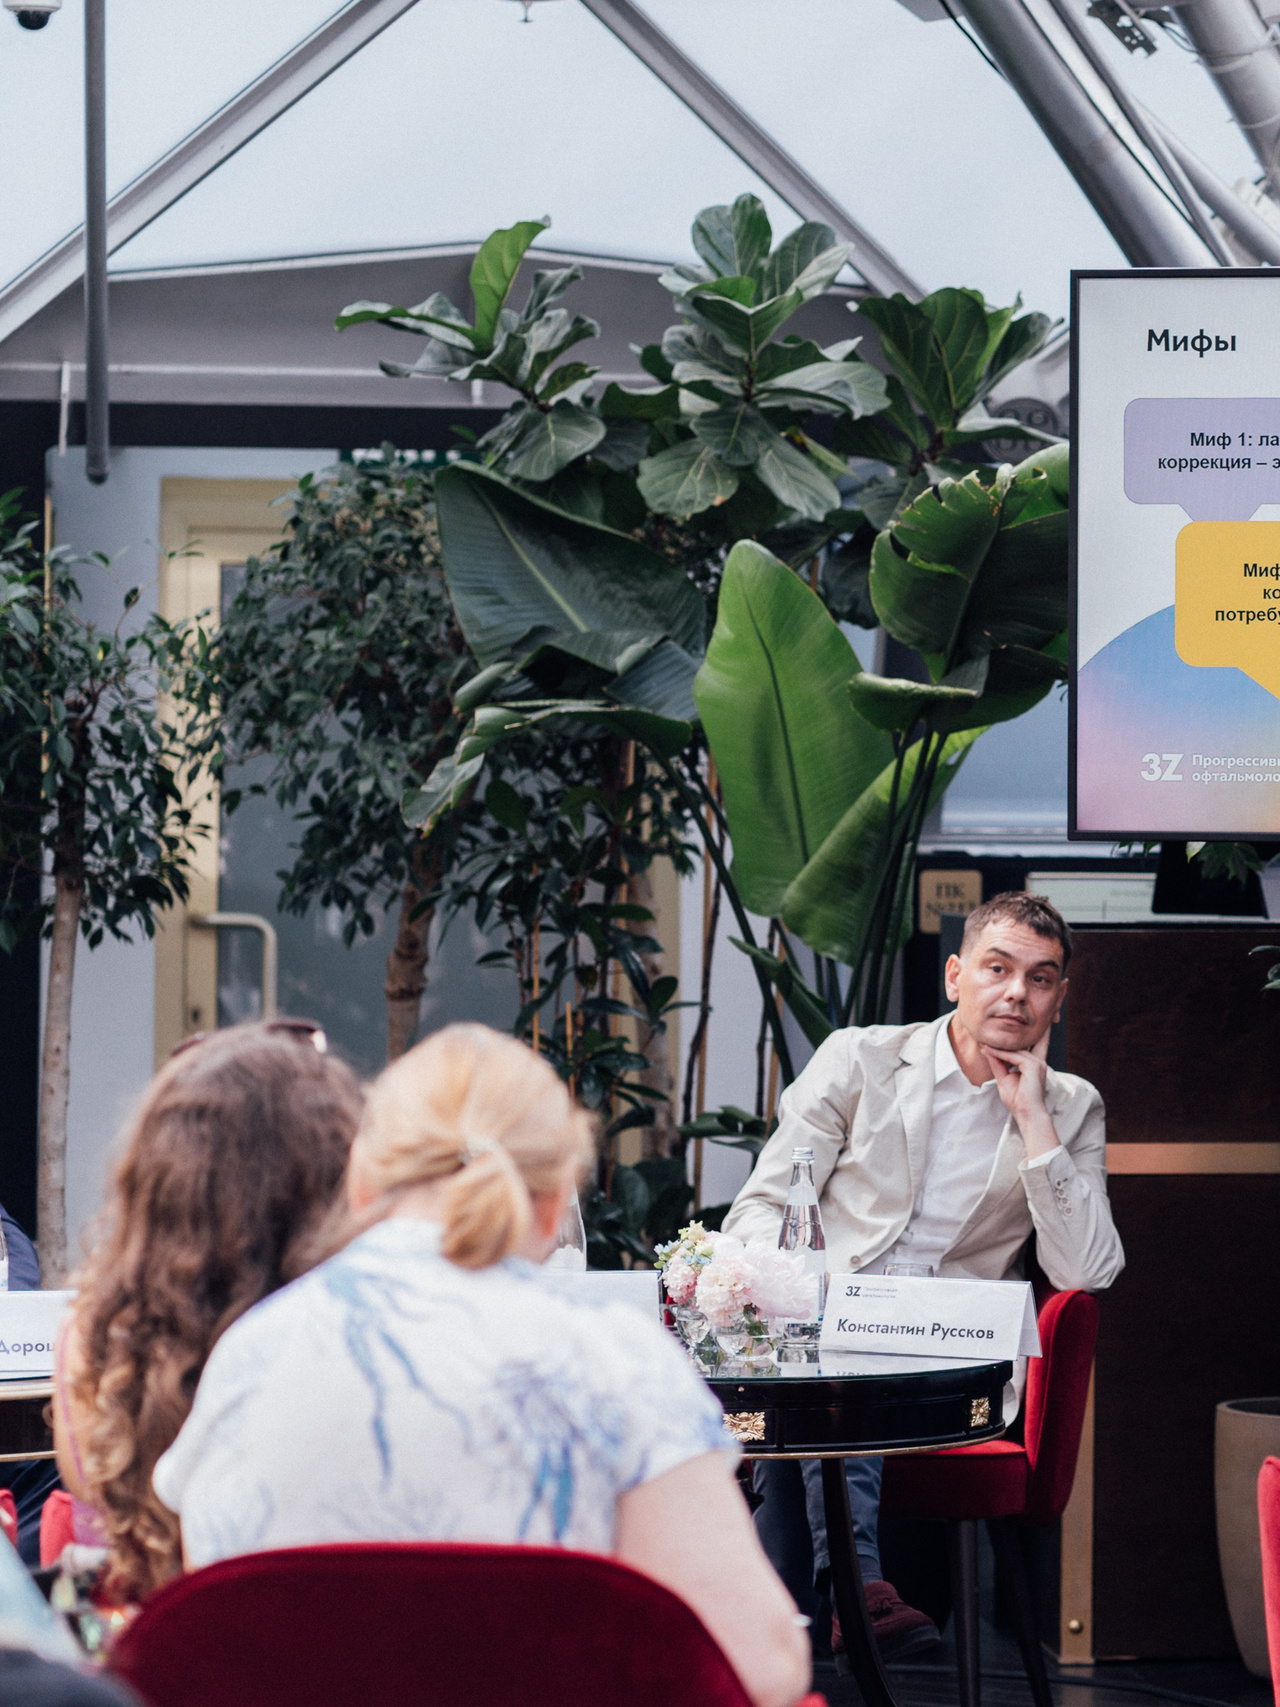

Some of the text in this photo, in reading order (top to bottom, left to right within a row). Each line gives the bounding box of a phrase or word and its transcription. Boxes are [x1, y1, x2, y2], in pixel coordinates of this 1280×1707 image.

[1146, 328, 1237, 358] Мифы
[1190, 432, 1232, 449] Миф
[1237, 432, 1253, 446] 1:
[1158, 457, 1252, 472] коррекция
[1140, 753, 1184, 782] 3Z
[845, 1285, 861, 1297] 3Z
[836, 1318, 995, 1341] Константин Руссков
